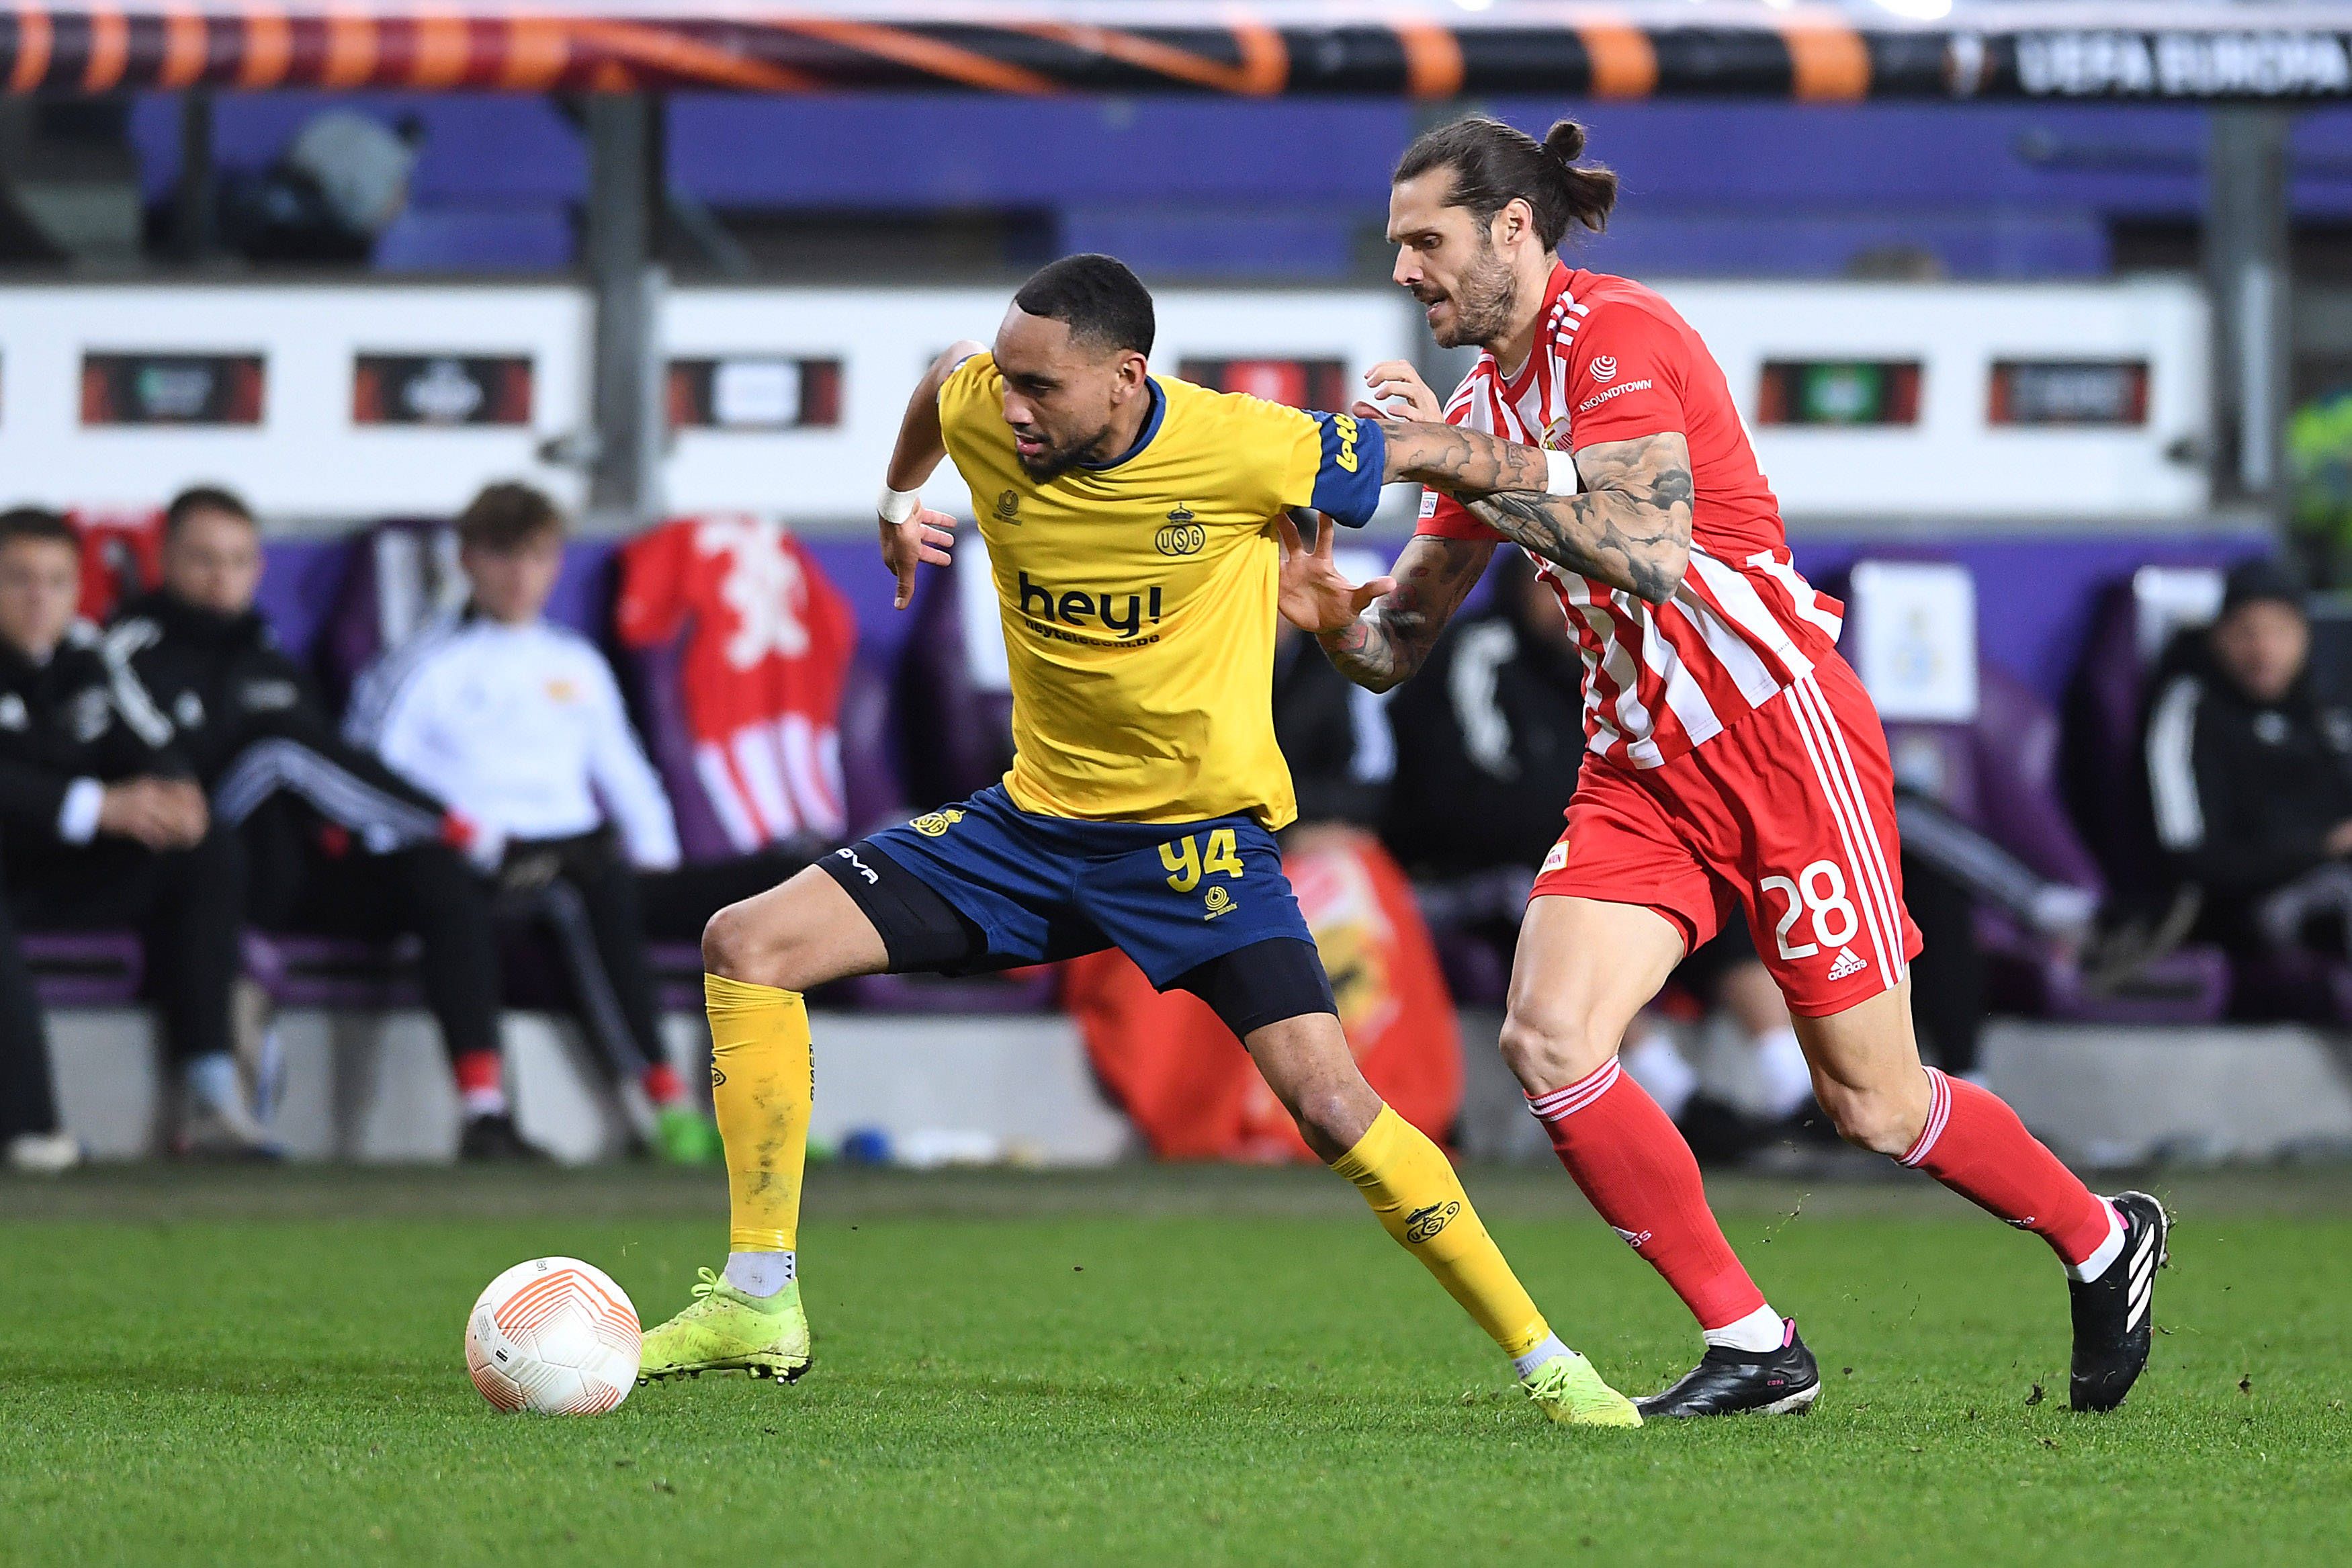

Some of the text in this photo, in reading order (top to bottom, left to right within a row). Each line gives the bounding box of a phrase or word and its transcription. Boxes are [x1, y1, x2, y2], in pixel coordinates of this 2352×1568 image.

[1579, 379, 1653, 412] AROUNDTOWN
[1161, 529, 1200, 549] USG
[1018, 570, 1162, 639] hey!
[1158, 828, 1245, 893] 94
[1759, 859, 1860, 961] 28
[1827, 959, 1868, 982] adidas
